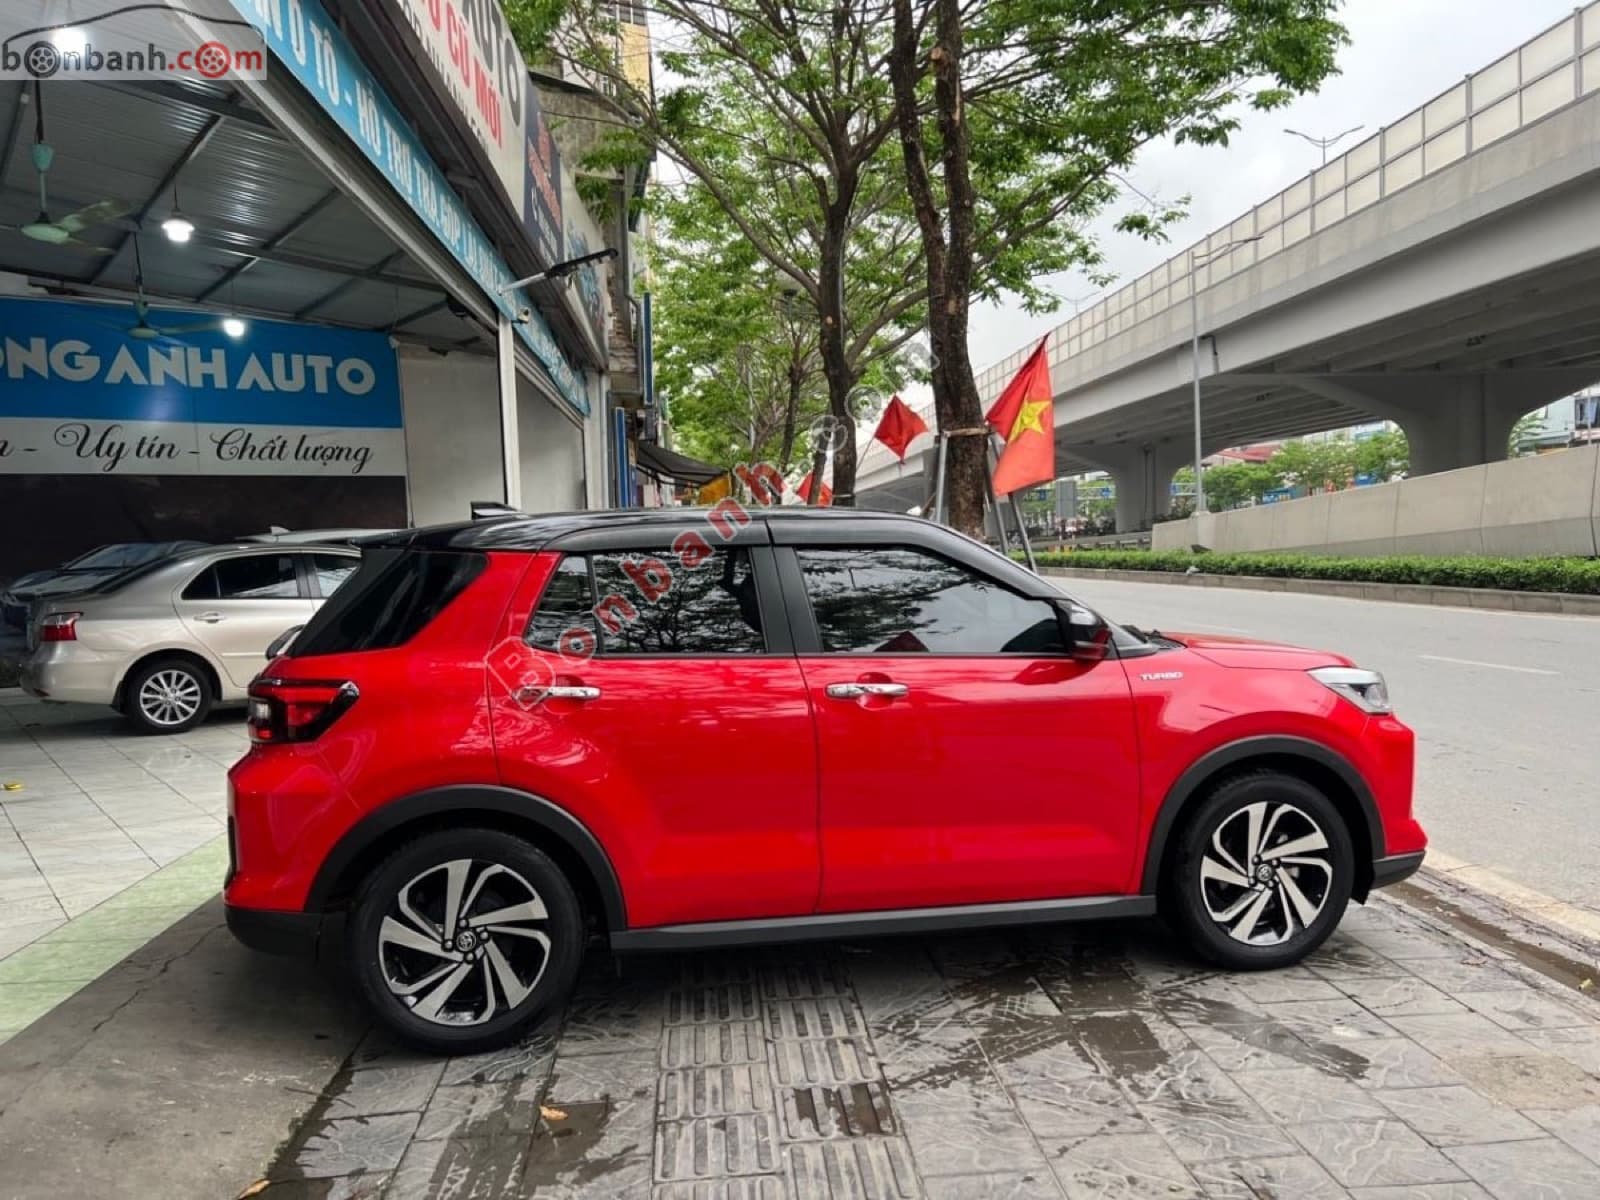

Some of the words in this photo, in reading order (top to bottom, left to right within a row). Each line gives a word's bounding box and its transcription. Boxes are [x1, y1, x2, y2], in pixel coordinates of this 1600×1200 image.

[309, 19, 340, 106] TÔ
[0, 337, 100, 382] NG
[104, 343, 228, 389] ANH
[236, 352, 375, 395] AUTO
[135, 435, 181, 459] tín
[209, 427, 289, 461] Chất
[294, 434, 374, 474] lượng
[1140, 671, 1184, 681] TURBO
